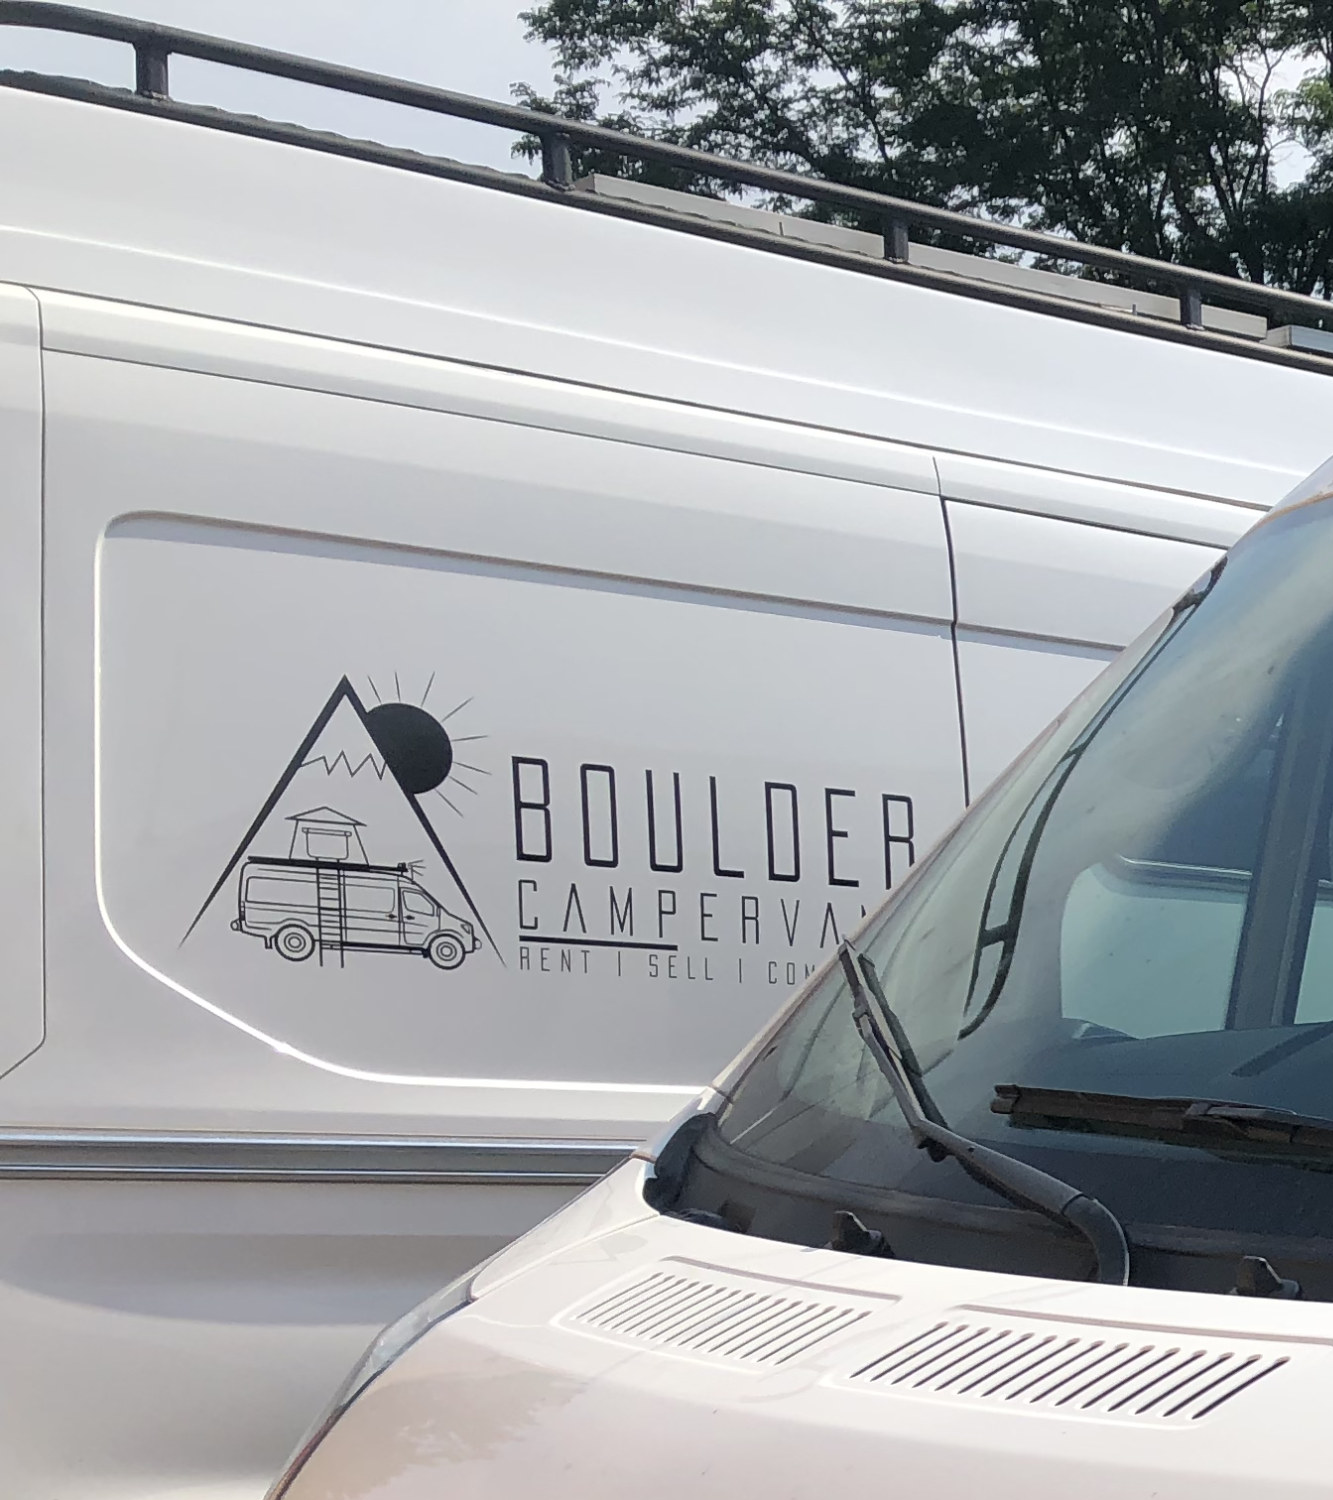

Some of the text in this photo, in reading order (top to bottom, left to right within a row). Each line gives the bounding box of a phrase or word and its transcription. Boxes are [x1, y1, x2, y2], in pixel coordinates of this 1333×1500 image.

[511, 755, 916, 890] BOULDER
[518, 879, 866, 949] CAMPERVA
[520, 946, 590, 974] RENT
[649, 954, 714, 981] SELL
